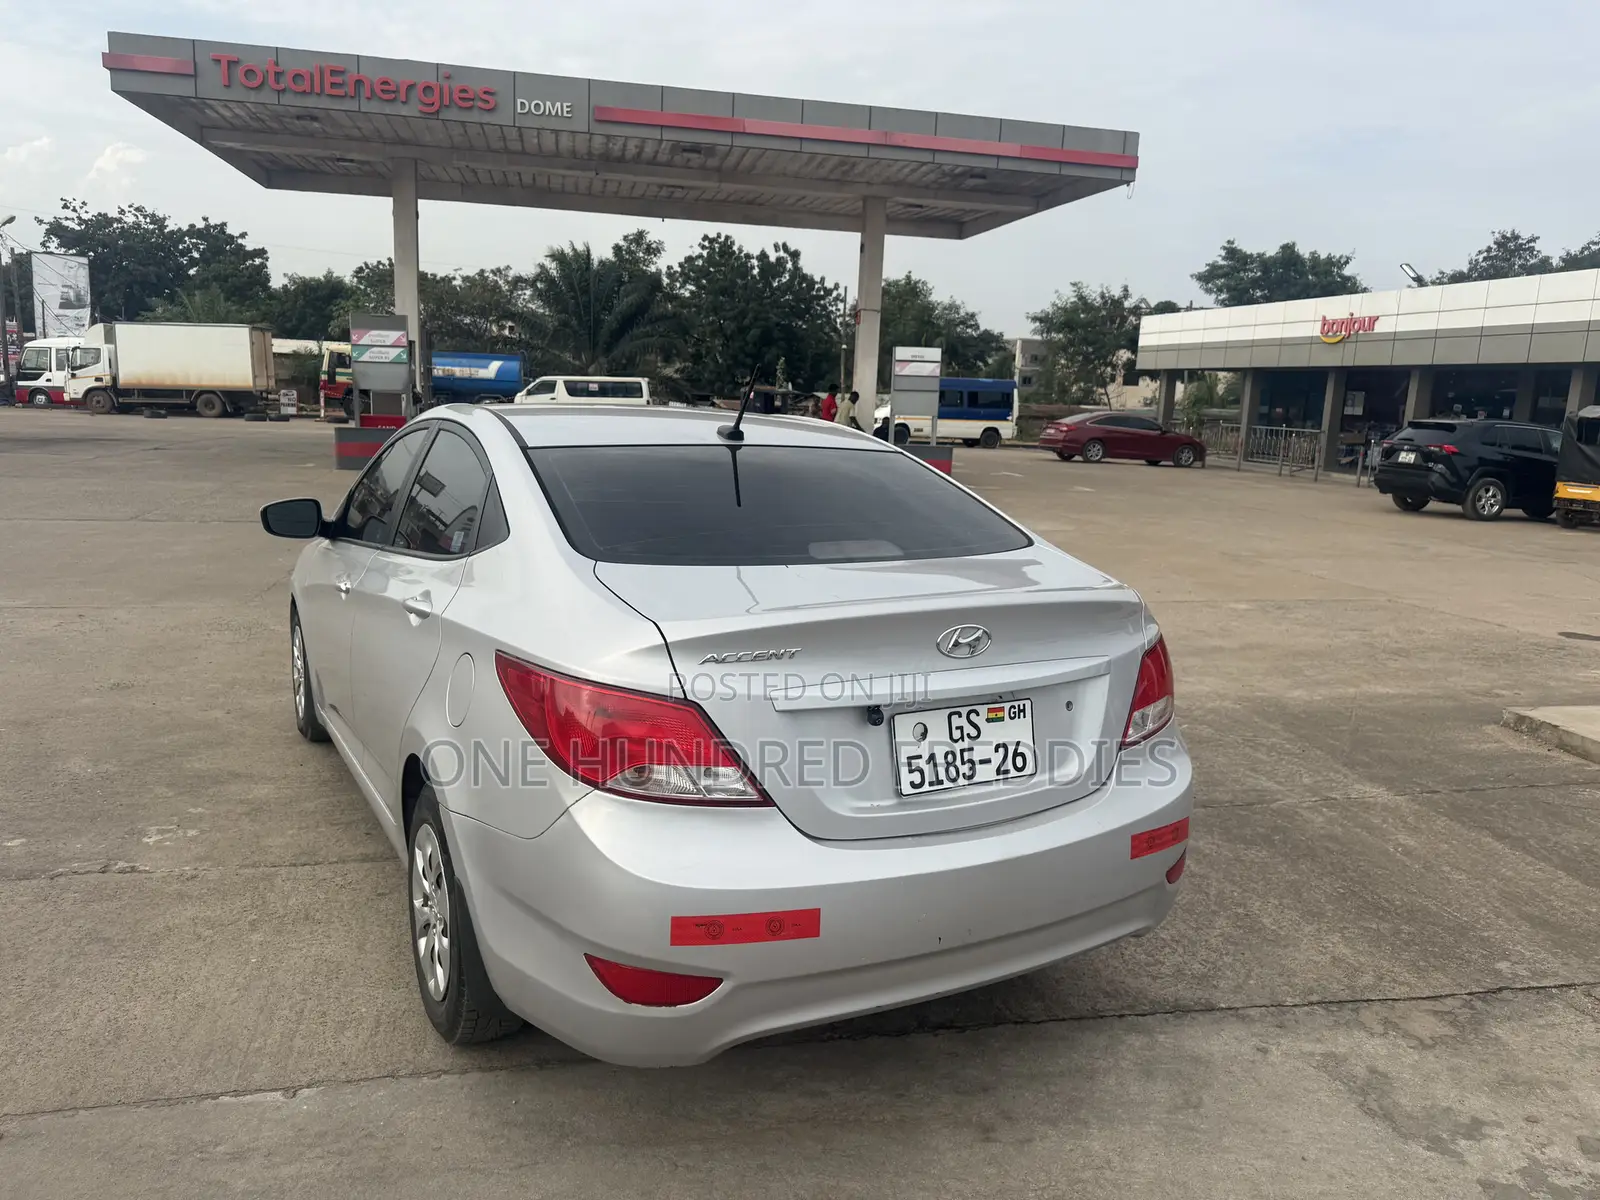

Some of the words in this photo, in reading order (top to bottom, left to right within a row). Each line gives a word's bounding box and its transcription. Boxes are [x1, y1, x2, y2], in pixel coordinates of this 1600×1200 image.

[210, 53, 496, 113] TotalEnergies
[516, 98, 573, 118] DOME
[1320, 312, 1379, 339] bonjour
[698, 648, 802, 665] ACCENT
[947, 708, 982, 744] GS
[1008, 703, 1027, 721] GH
[906, 740, 1027, 790] 5185-26
